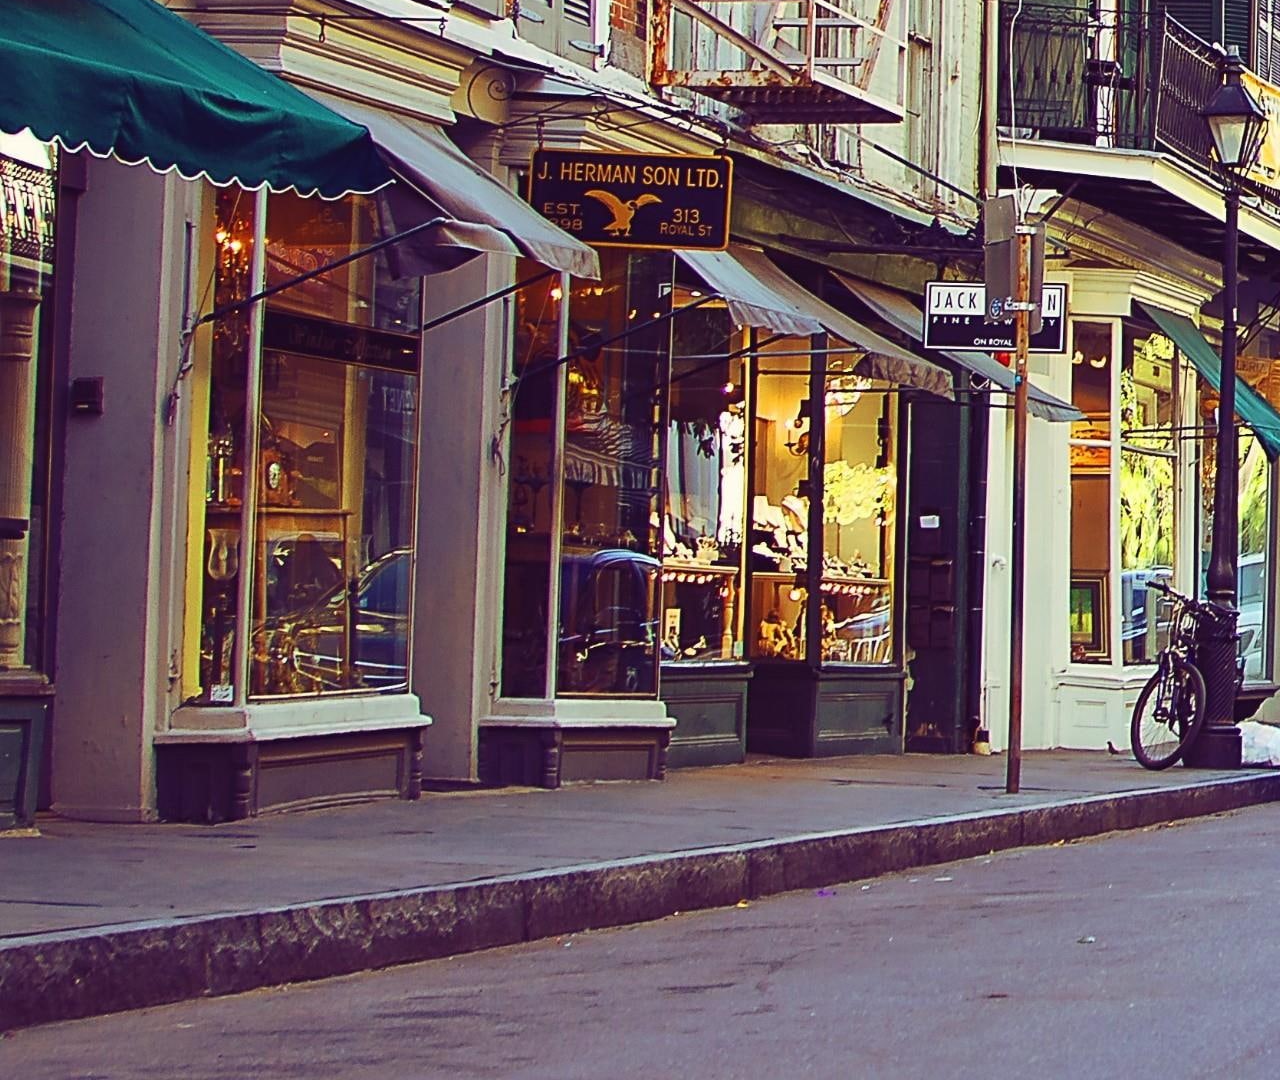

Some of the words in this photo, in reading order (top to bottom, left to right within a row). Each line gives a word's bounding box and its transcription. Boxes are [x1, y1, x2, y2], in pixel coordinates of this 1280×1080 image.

[537, 161, 553, 180] J.
[560, 162, 636, 184] HERMAN
[642, 166, 680, 187] SON
[686, 168, 724, 189] LTD.
[544, 202, 584, 216] EST.
[672, 208, 700, 224] 313
[660, 222, 695, 237] ROYAL
[698, 224, 713, 237] ST
[934, 291, 977, 309] JACK
[932, 316, 970, 325] FINE
[973, 337, 987, 346] ON
[988, 337, 1013, 347] ROYAL
